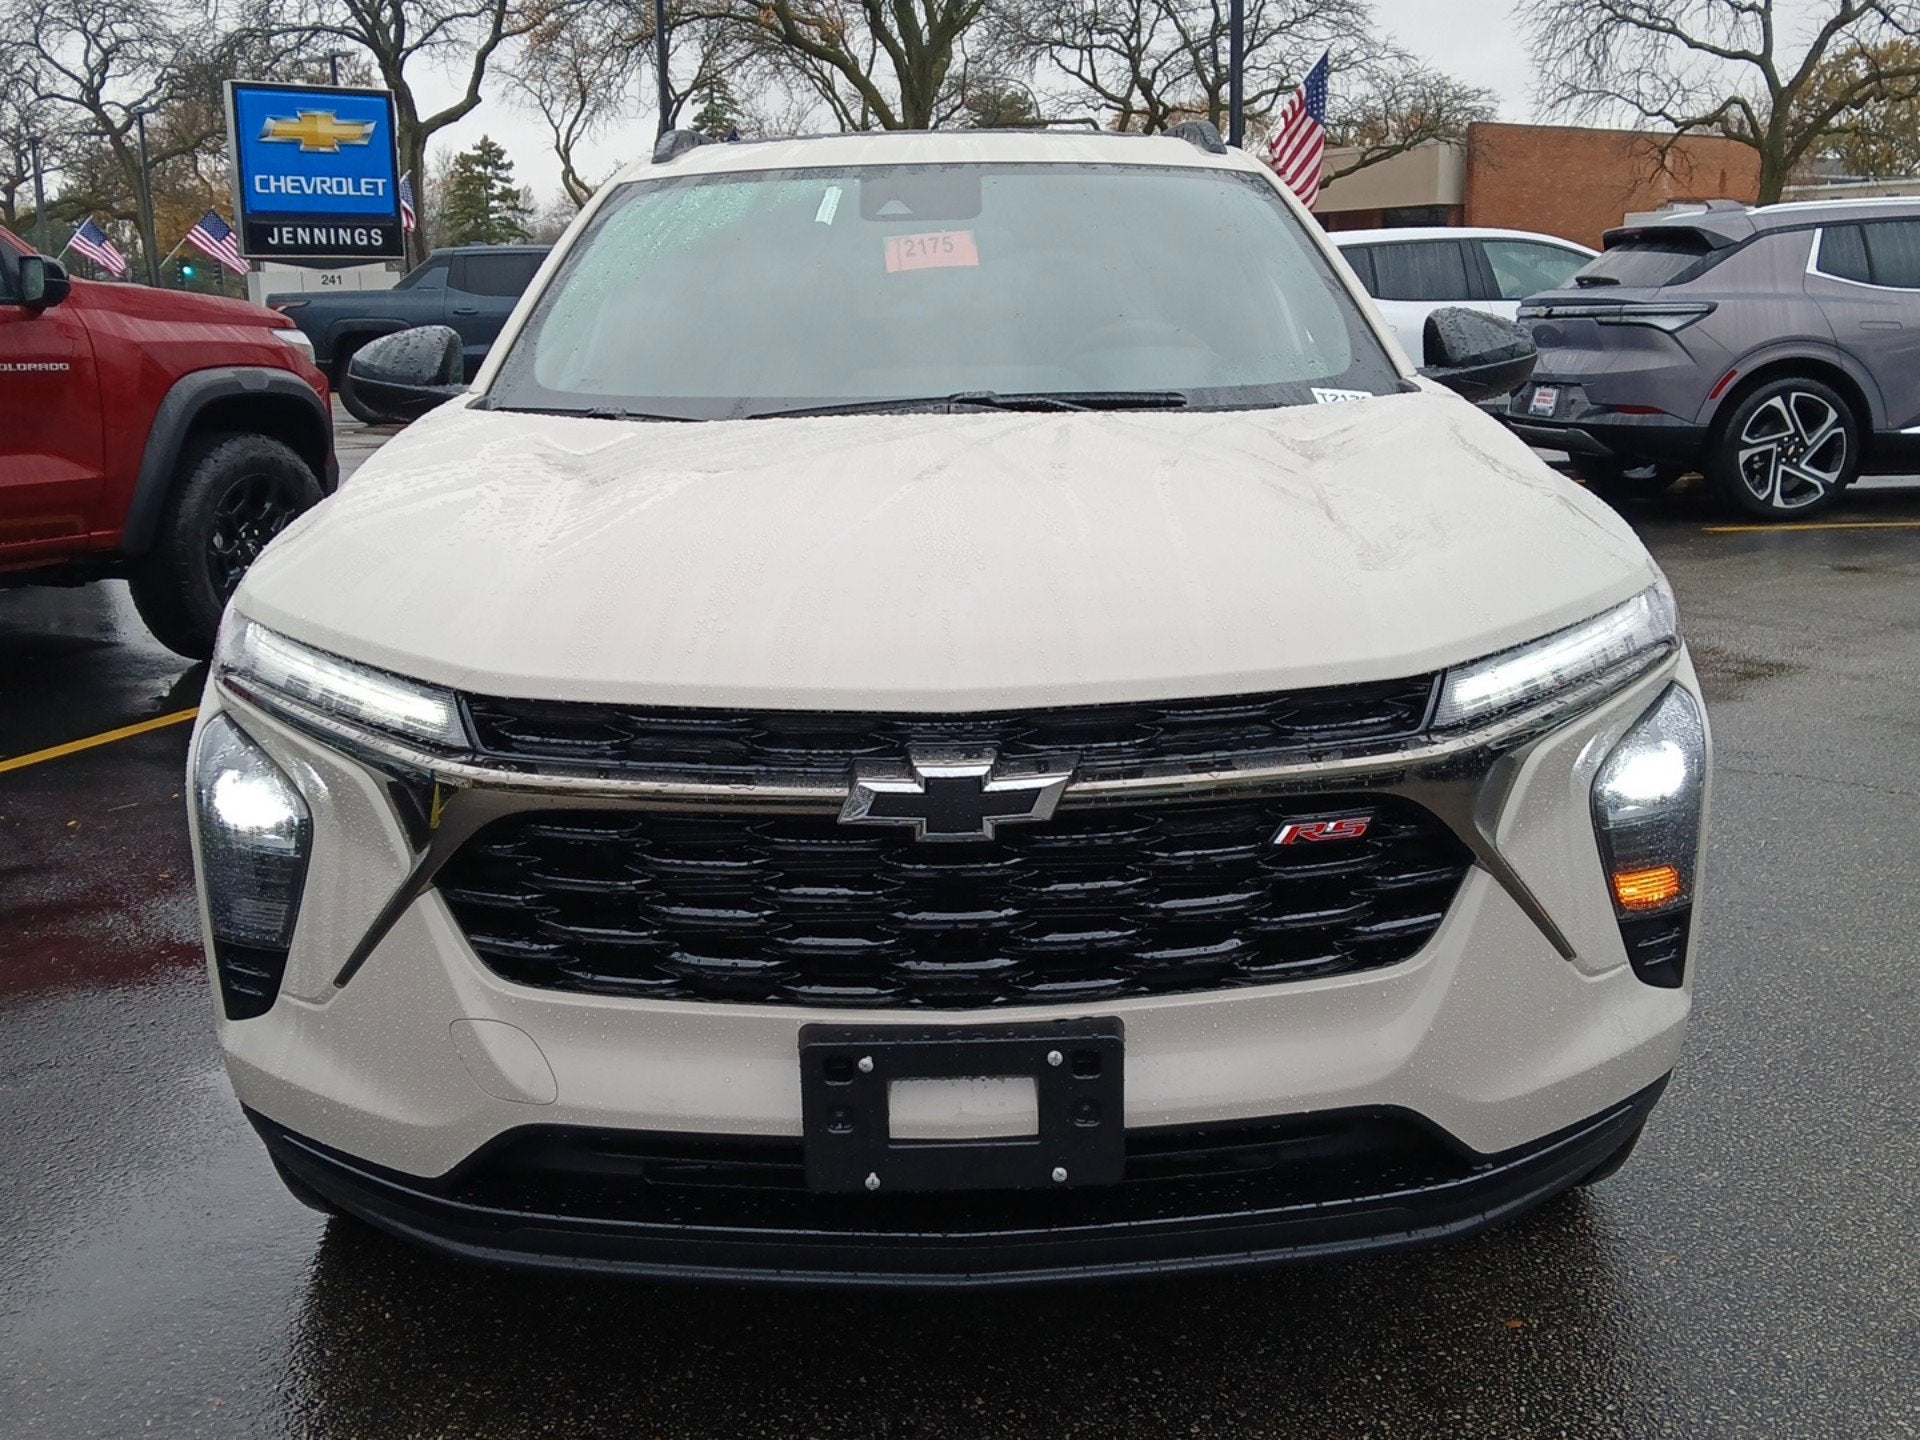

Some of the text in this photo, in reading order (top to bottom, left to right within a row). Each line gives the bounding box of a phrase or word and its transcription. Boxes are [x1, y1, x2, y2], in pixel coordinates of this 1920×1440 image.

[254, 175, 387, 196] CHEVROLET
[267, 227, 383, 245] JENNINGS
[905, 236, 953, 257] 2175
[321, 274, 342, 285] 241
[0, 363, 70, 371] OLORADO
[1273, 817, 1371, 845] RS
